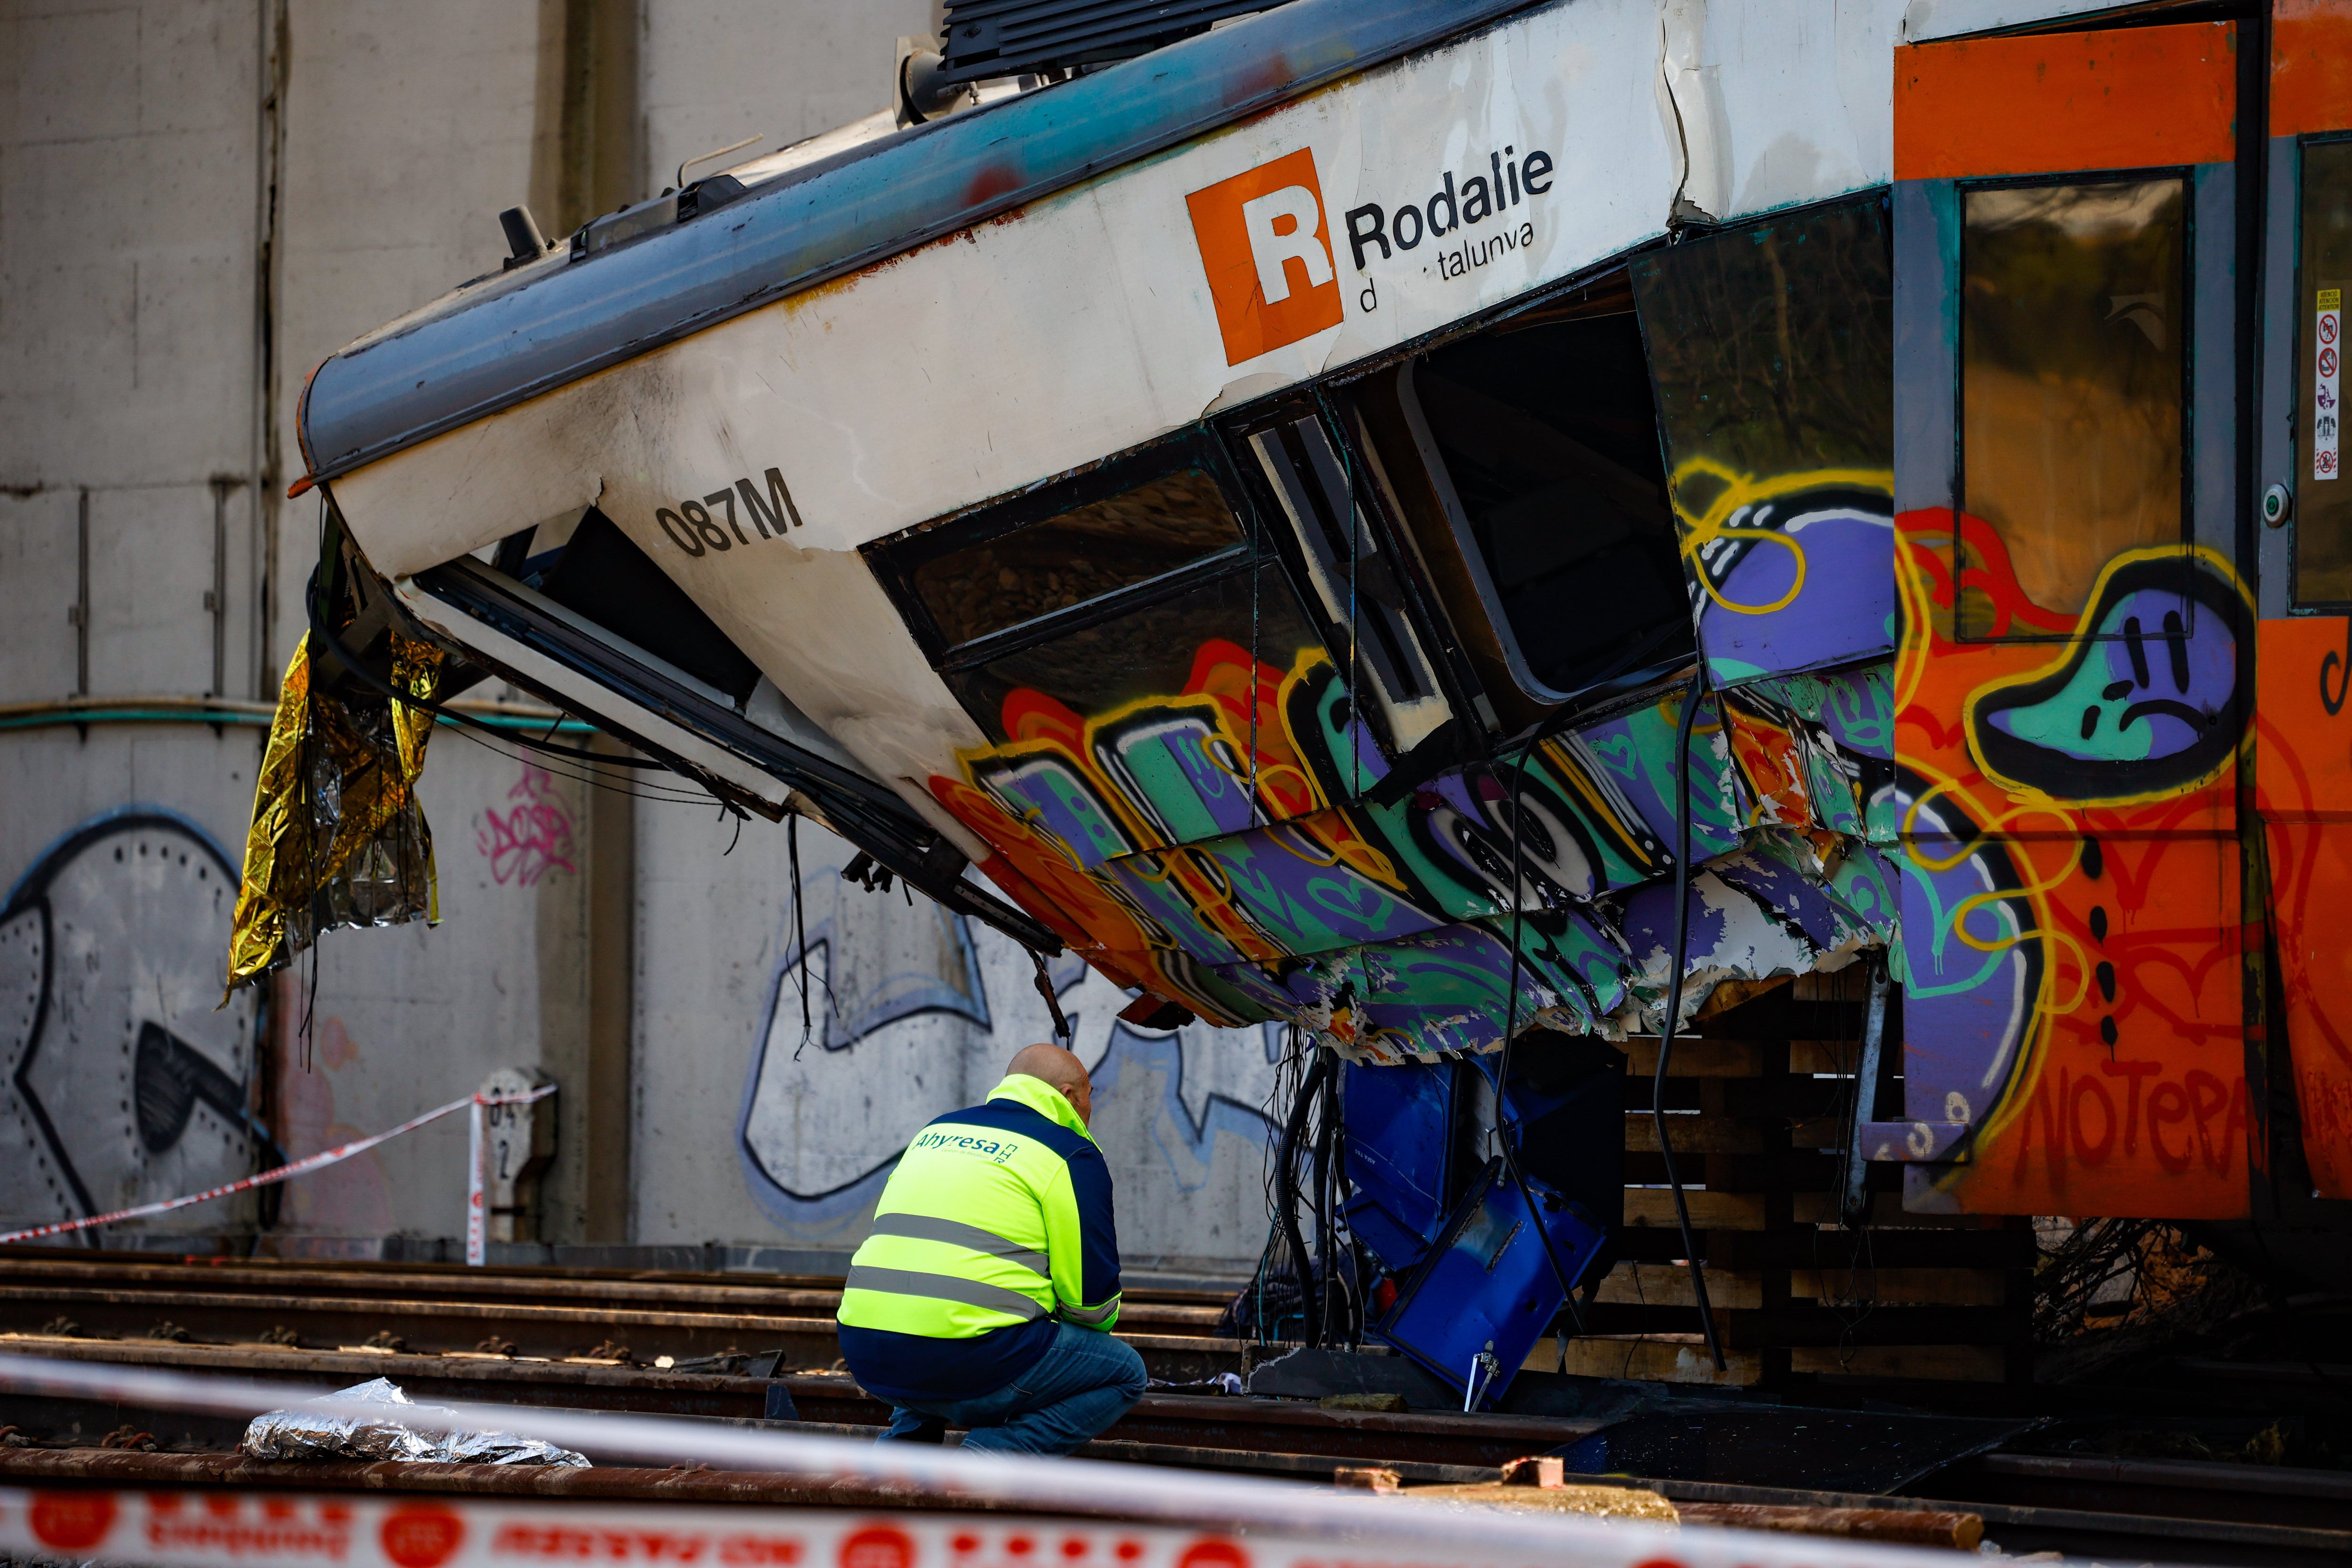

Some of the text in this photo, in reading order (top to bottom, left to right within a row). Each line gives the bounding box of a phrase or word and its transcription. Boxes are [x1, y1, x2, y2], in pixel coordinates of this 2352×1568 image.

[1242, 185, 1335, 305] R
[655, 467, 803, 557] 087M
[911, 1132, 1000, 1154] Ahyresa
[1364, 1154, 1375, 1164] ASFA
